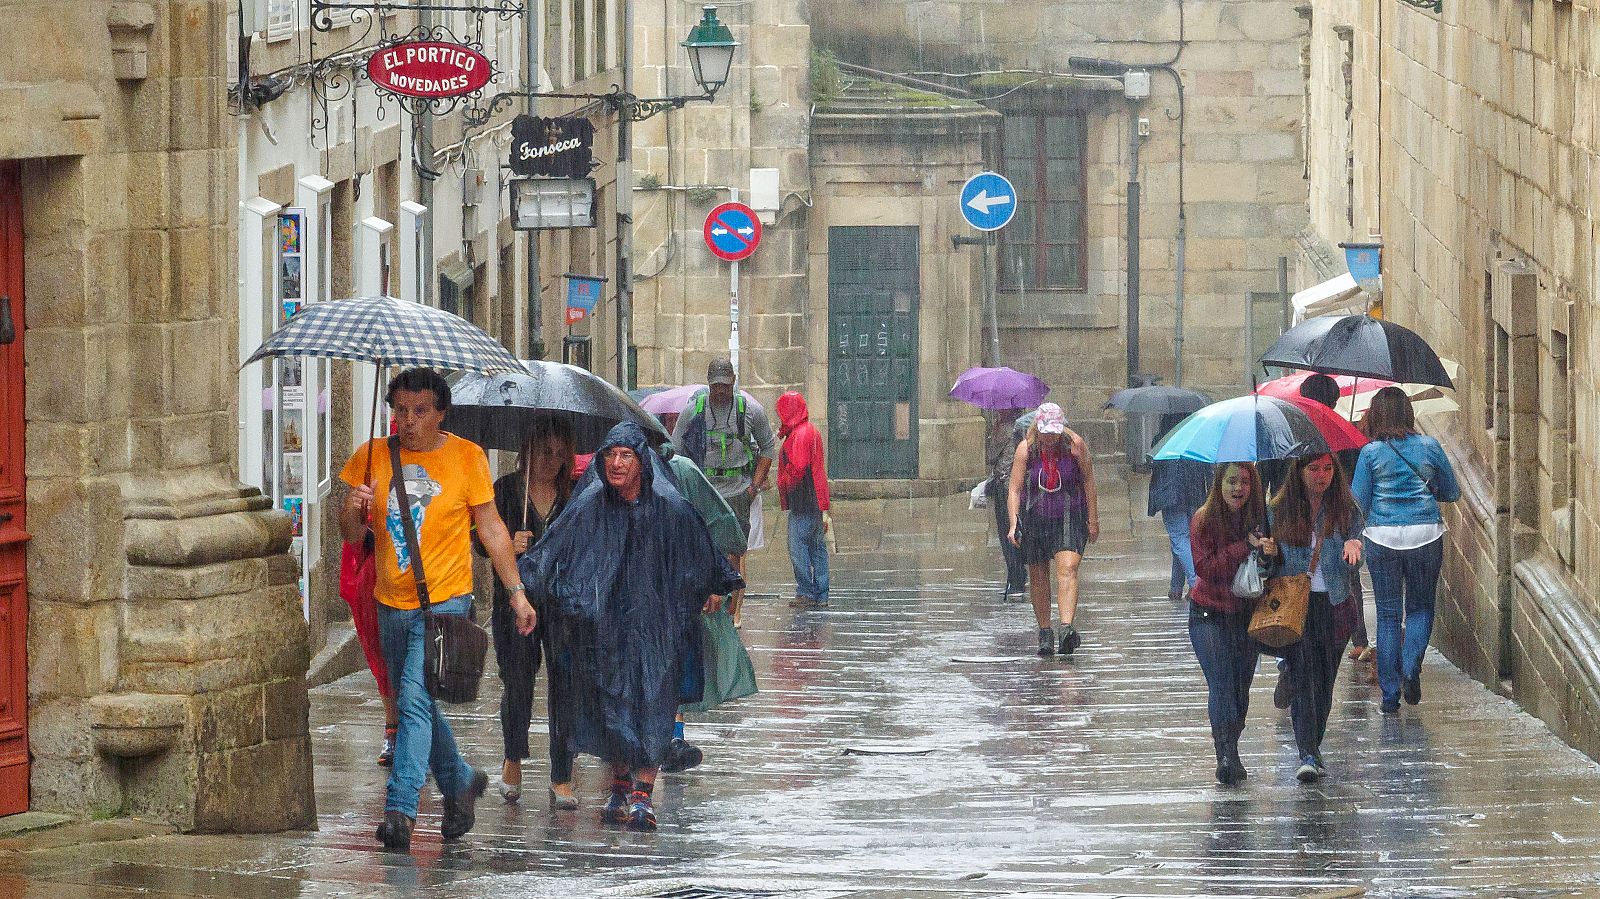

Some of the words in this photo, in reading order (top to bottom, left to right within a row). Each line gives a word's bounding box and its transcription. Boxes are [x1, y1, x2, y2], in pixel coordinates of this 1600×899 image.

[383, 51, 404, 71] EL
[406, 47, 476, 72] PORTICO
[390, 72, 469, 92] NOVEDADES
[520, 138, 582, 161] Fonseca
